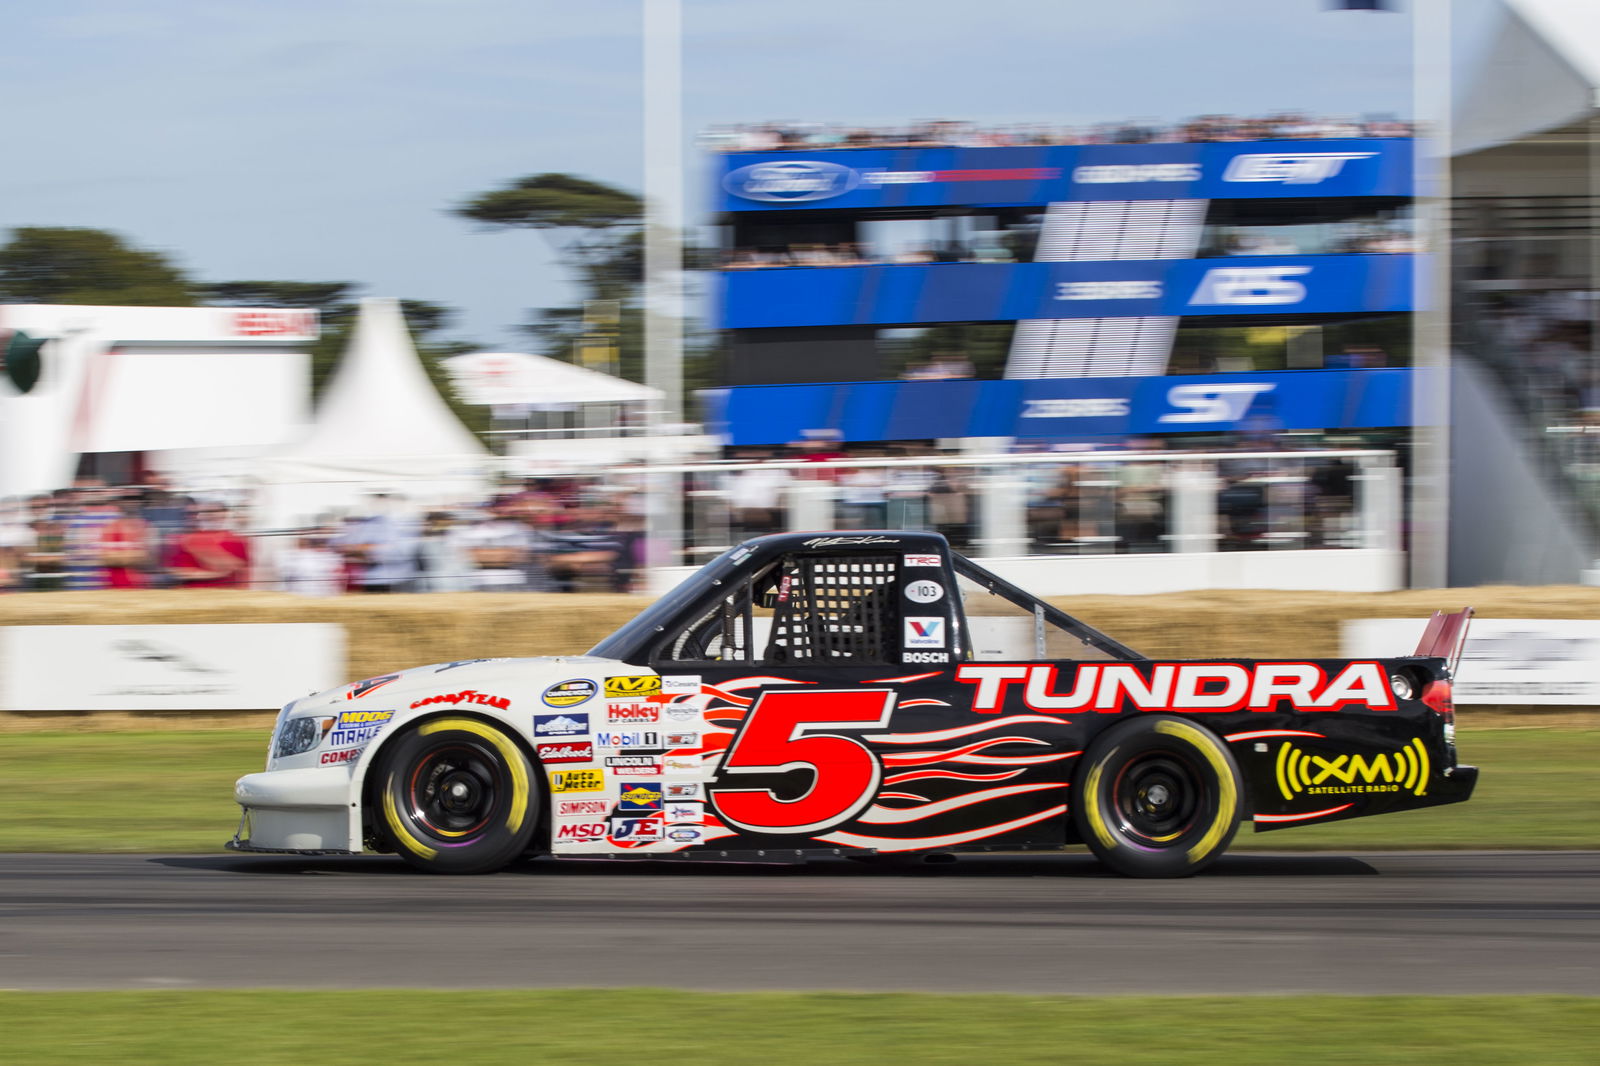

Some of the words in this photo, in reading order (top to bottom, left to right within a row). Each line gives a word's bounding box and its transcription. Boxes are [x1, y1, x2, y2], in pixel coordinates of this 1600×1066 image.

[902, 652, 949, 663] BOSCH
[956, 662, 1397, 713] TUNDRA
[410, 690, 511, 710] GOODYEAR
[608, 704, 659, 722] Holley
[331, 726, 382, 746] MAHLE
[597, 733, 640, 746] Mobil
[606, 757, 653, 766] LINCOLN
[709, 688, 898, 834] 5
[566, 772, 594, 780] Auto
[560, 801, 606, 815] SIMPSON
[558, 823, 605, 838] MSD
[614, 819, 659, 839] JE
